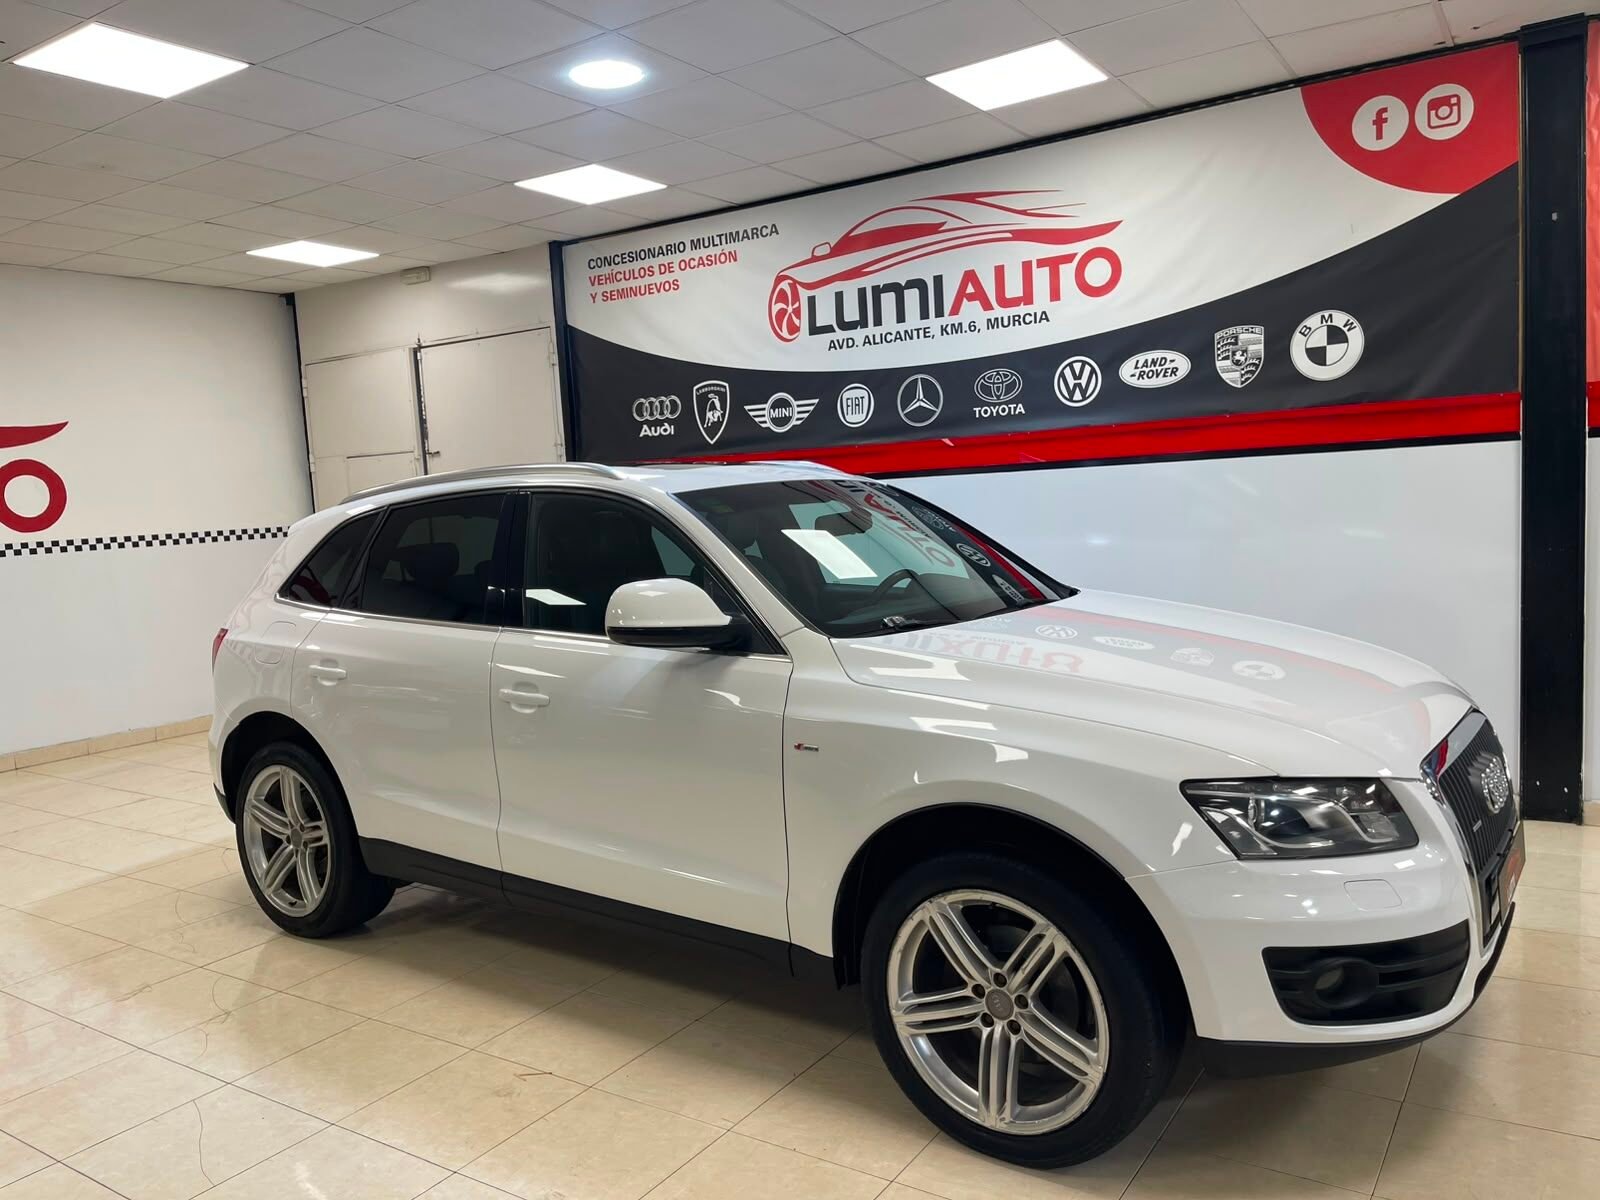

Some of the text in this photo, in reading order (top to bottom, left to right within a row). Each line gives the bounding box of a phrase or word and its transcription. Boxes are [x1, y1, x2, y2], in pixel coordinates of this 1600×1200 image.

[1372, 107, 1389, 141] f
[588, 223, 780, 270] CONCESIONARIO MULTIMARCA
[588, 248, 738, 287] VEHÍCULOS DE OCASIÓN
[590, 279, 680, 304] Y SEMINUEVOS
[827, 310, 1050, 351] AVD. ALICANTE, KM.6, MURCIA
[1216, 326, 1262, 340] PORSCHE
[769, 407, 793, 419] MINI
[846, 395, 865, 416] FIAT
[973, 403, 1026, 418] TOYOTA
[639, 422, 675, 438] Audi
